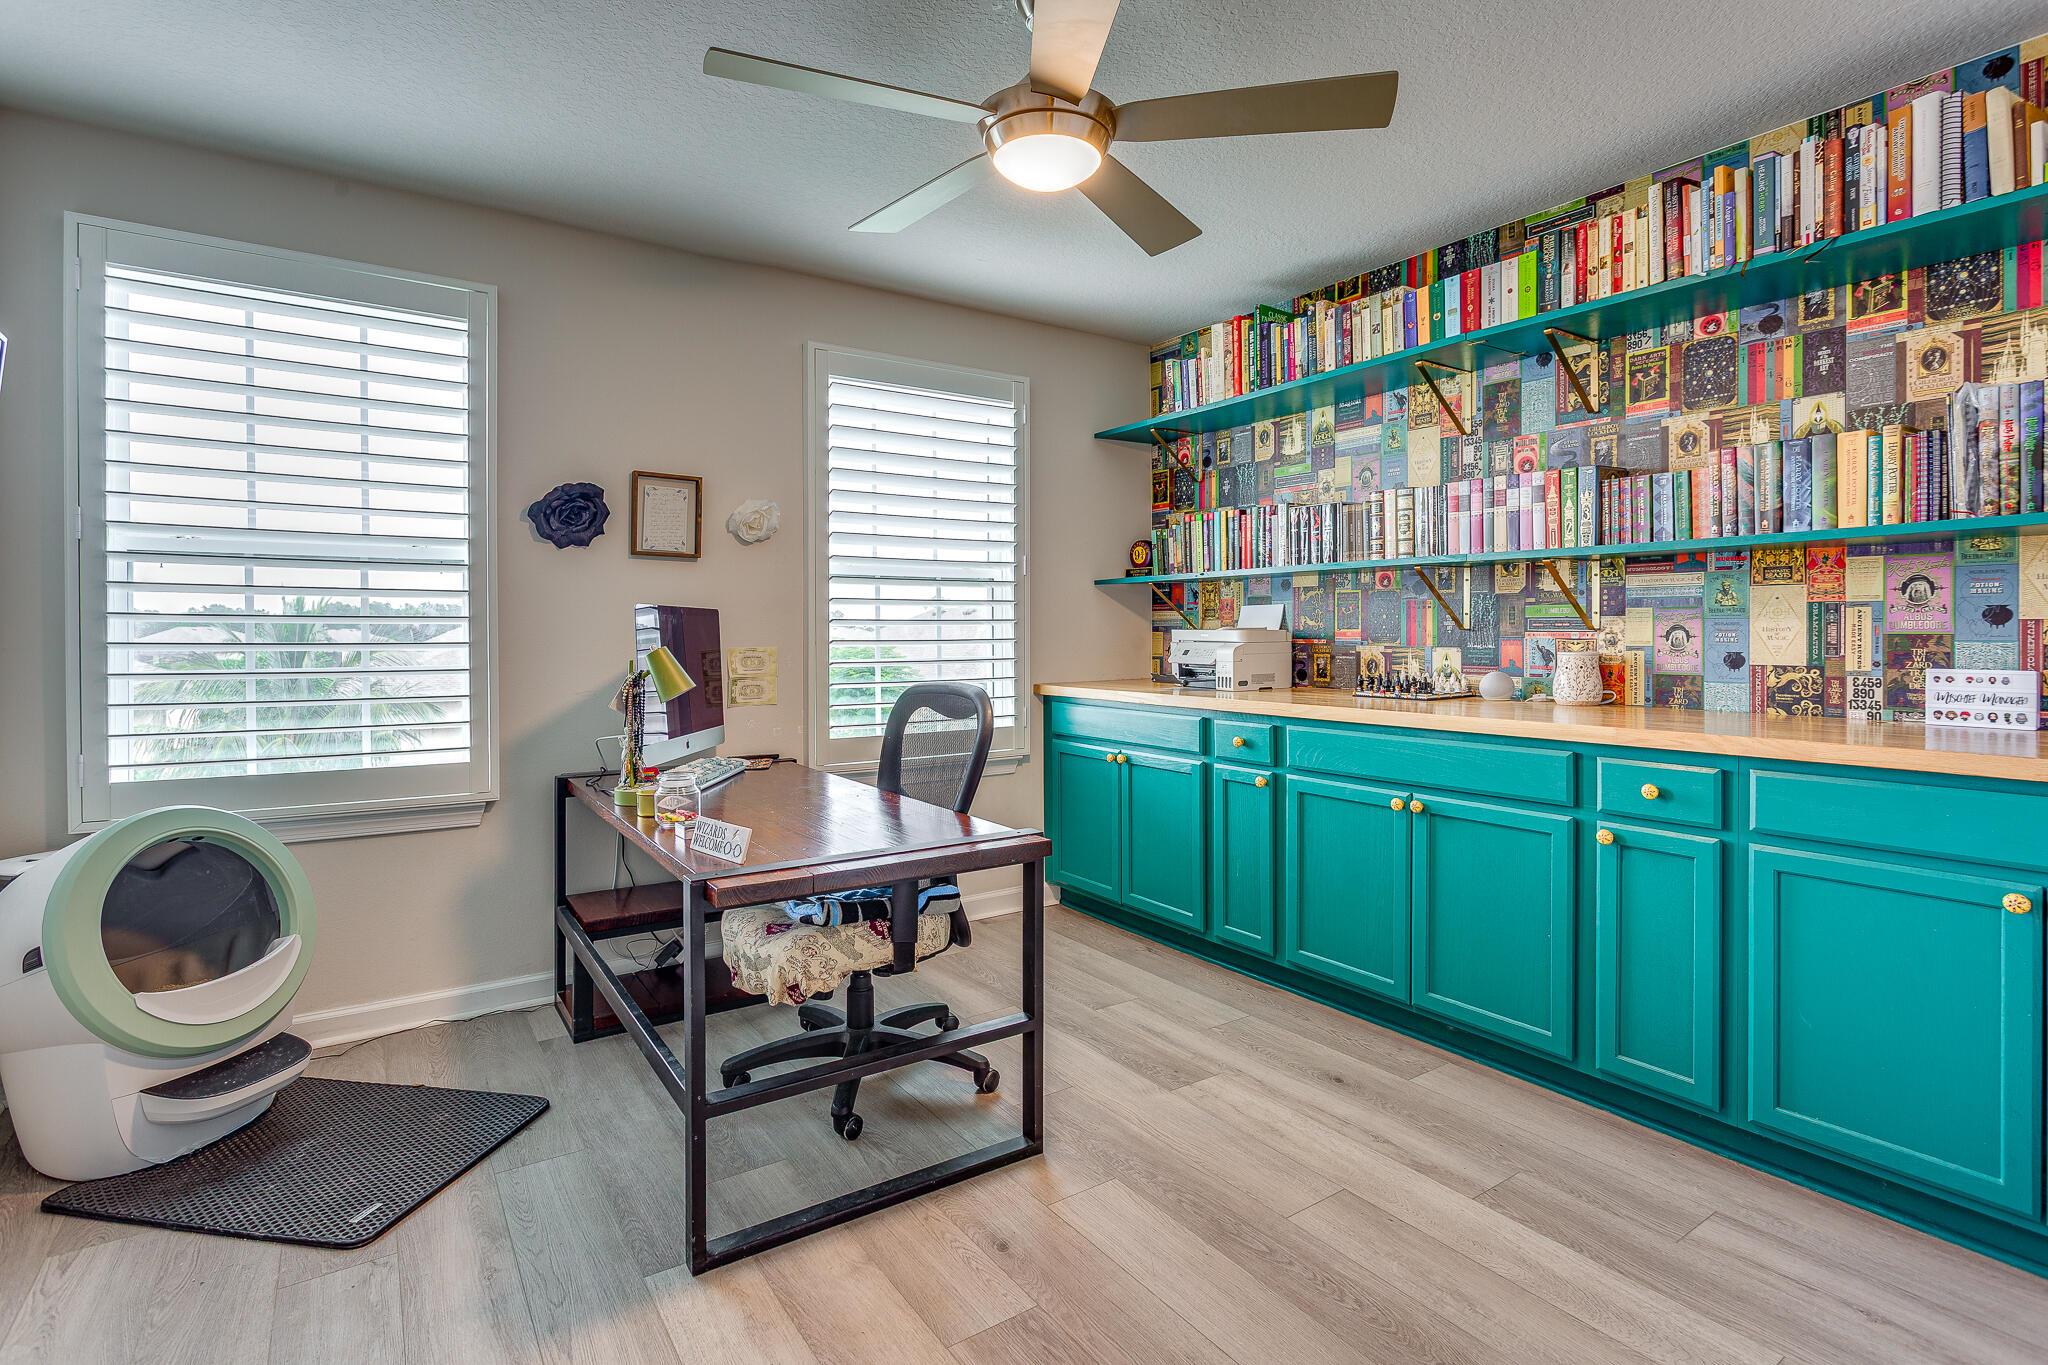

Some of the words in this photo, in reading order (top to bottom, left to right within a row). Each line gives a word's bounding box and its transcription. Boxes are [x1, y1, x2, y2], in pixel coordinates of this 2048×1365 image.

[1828, 170, 1837, 191] Calling
[1725, 206, 1733, 224] Angel
[1627, 340, 1642, 350] 890
[1849, 351, 1894, 363] CONSPIRACY
[2003, 419, 2015, 434] Harry
[2024, 417, 2038, 432] Harry
[2003, 434, 2015, 453] Potter
[2024, 432, 2038, 451] Potter
[1888, 442, 1898, 466] HARRY
[1795, 455, 1803, 482] HARRY
[1888, 467, 1898, 495] POTTER
[1795, 483, 1803, 510] POTTER
[1904, 613, 1934, 621] ALBUS
[1889, 621, 1948, 630] DUMBLEDORE
[1910, 648, 1926, 656] TRI
[1905, 661, 1932, 669] ZARD
[1852, 689, 1875, 699] 890
[1936, 692, 1976, 704] MISCHIEF
[1866, 711, 1882, 720] 90
[697, 820, 727, 841] WIZARDS
[692, 832, 725, 854] WELCOME
